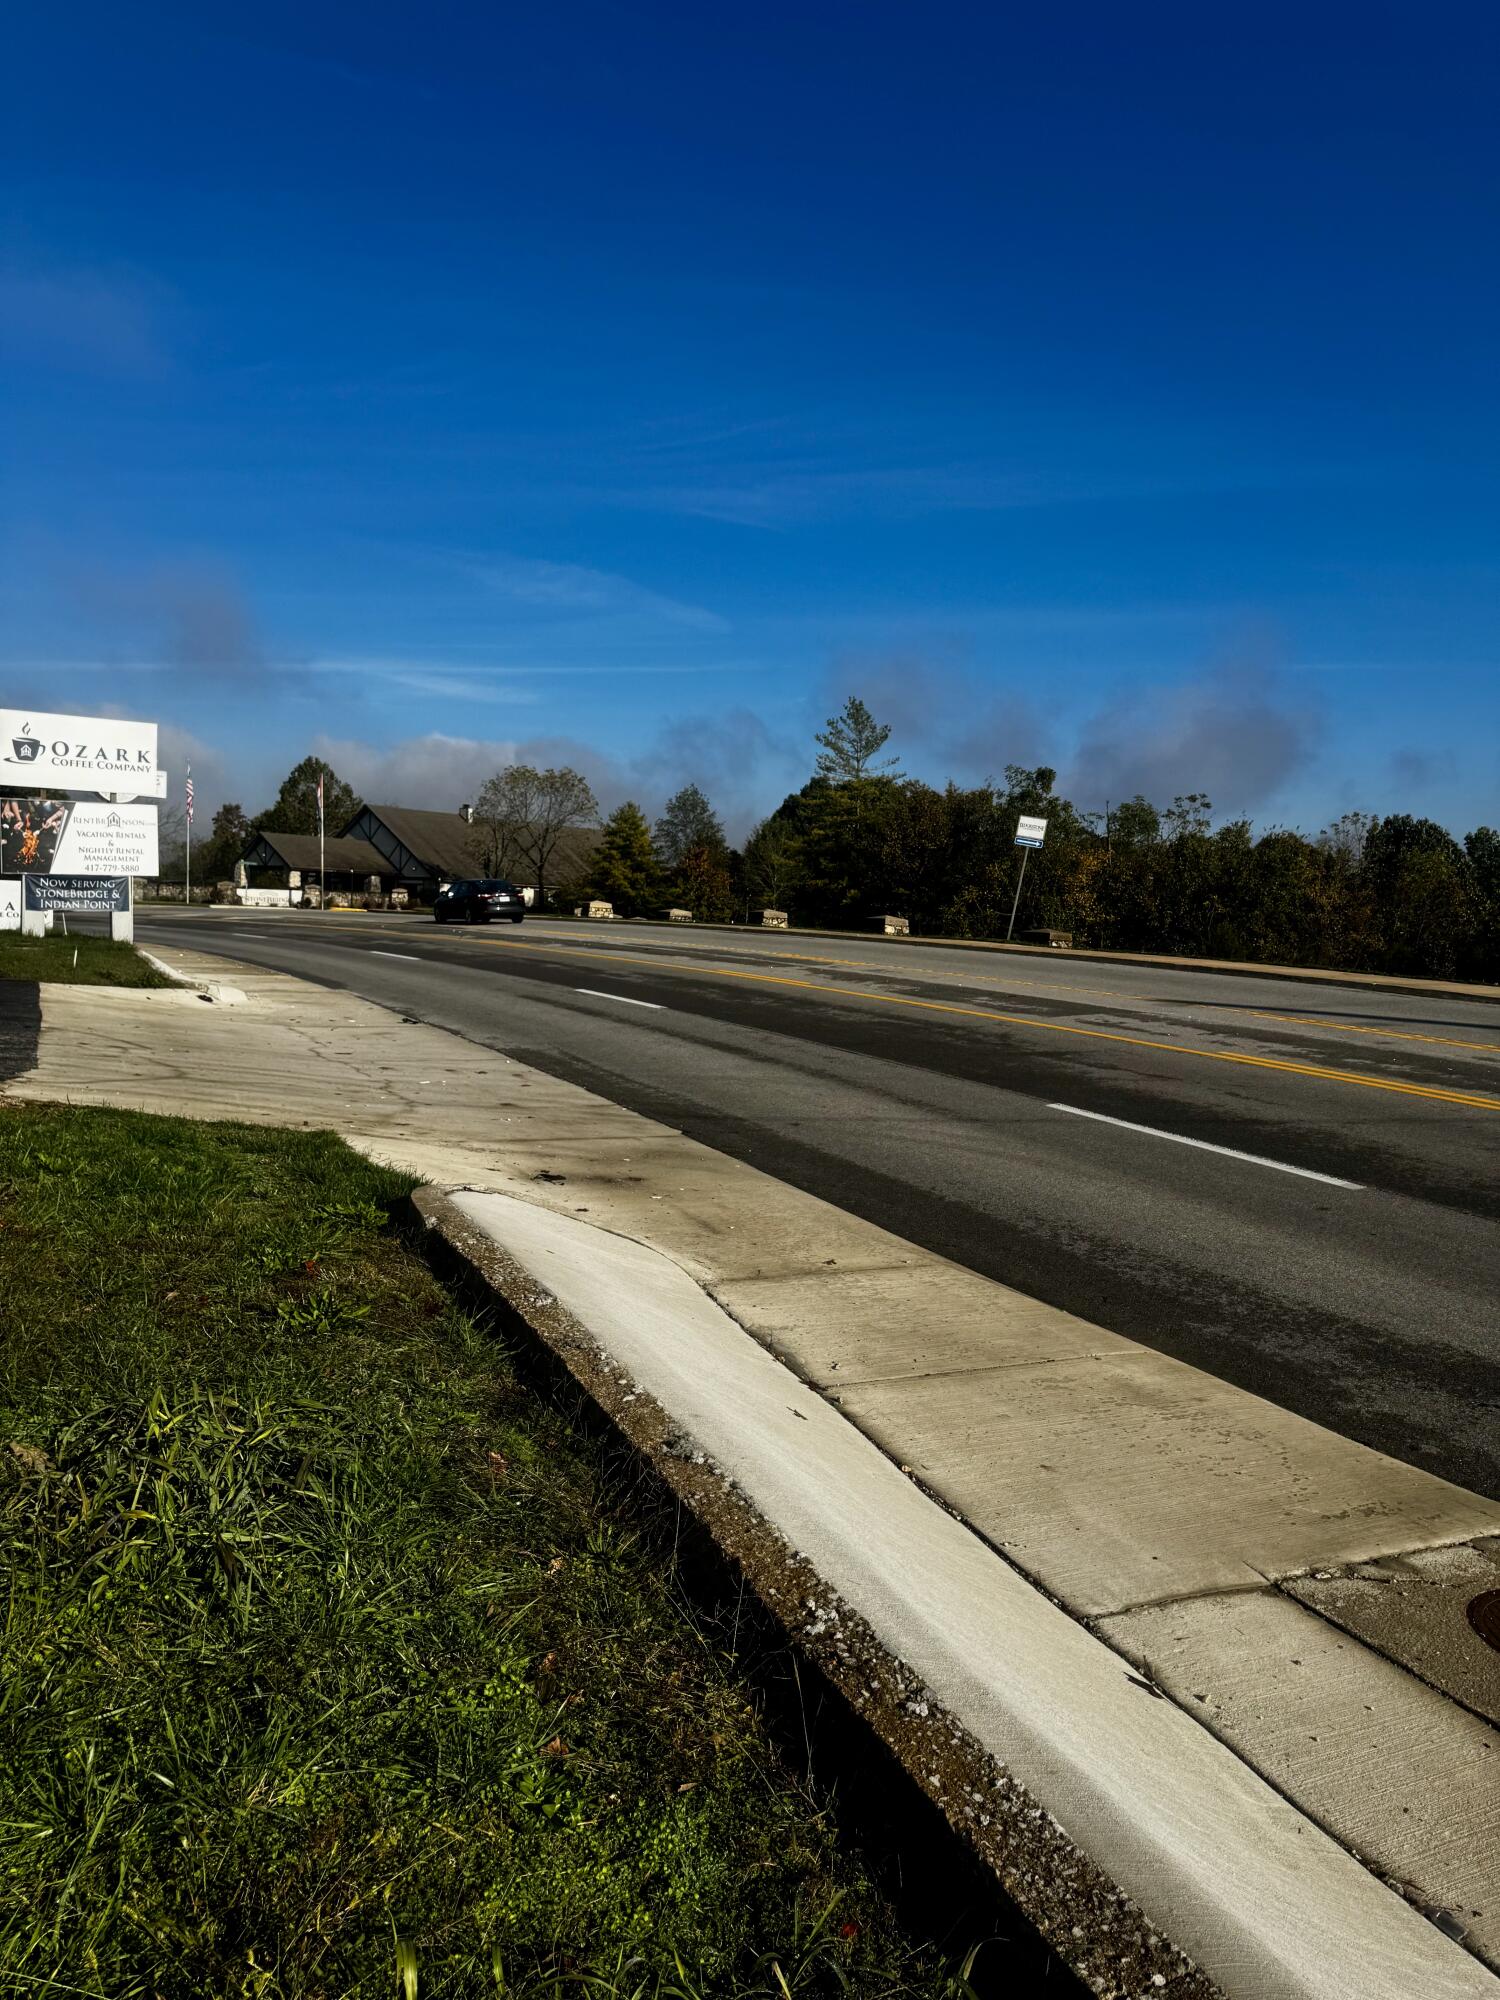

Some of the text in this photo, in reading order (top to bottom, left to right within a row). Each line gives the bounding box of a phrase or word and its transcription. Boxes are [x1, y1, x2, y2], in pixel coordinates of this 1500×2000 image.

[51, 740, 151, 764] OZARK
[51, 757, 152, 773] COFFEE COMPANY
[76, 830, 146, 839] VACATION RENTALS
[78, 846, 144, 855] NIGHTLY RENTAL
[83, 854, 140, 862] MANAGEMENT
[40, 877, 116, 889] NOW SERVING
[111, 889, 120, 899] &
[40, 898, 117, 910] INDIAN POINT
